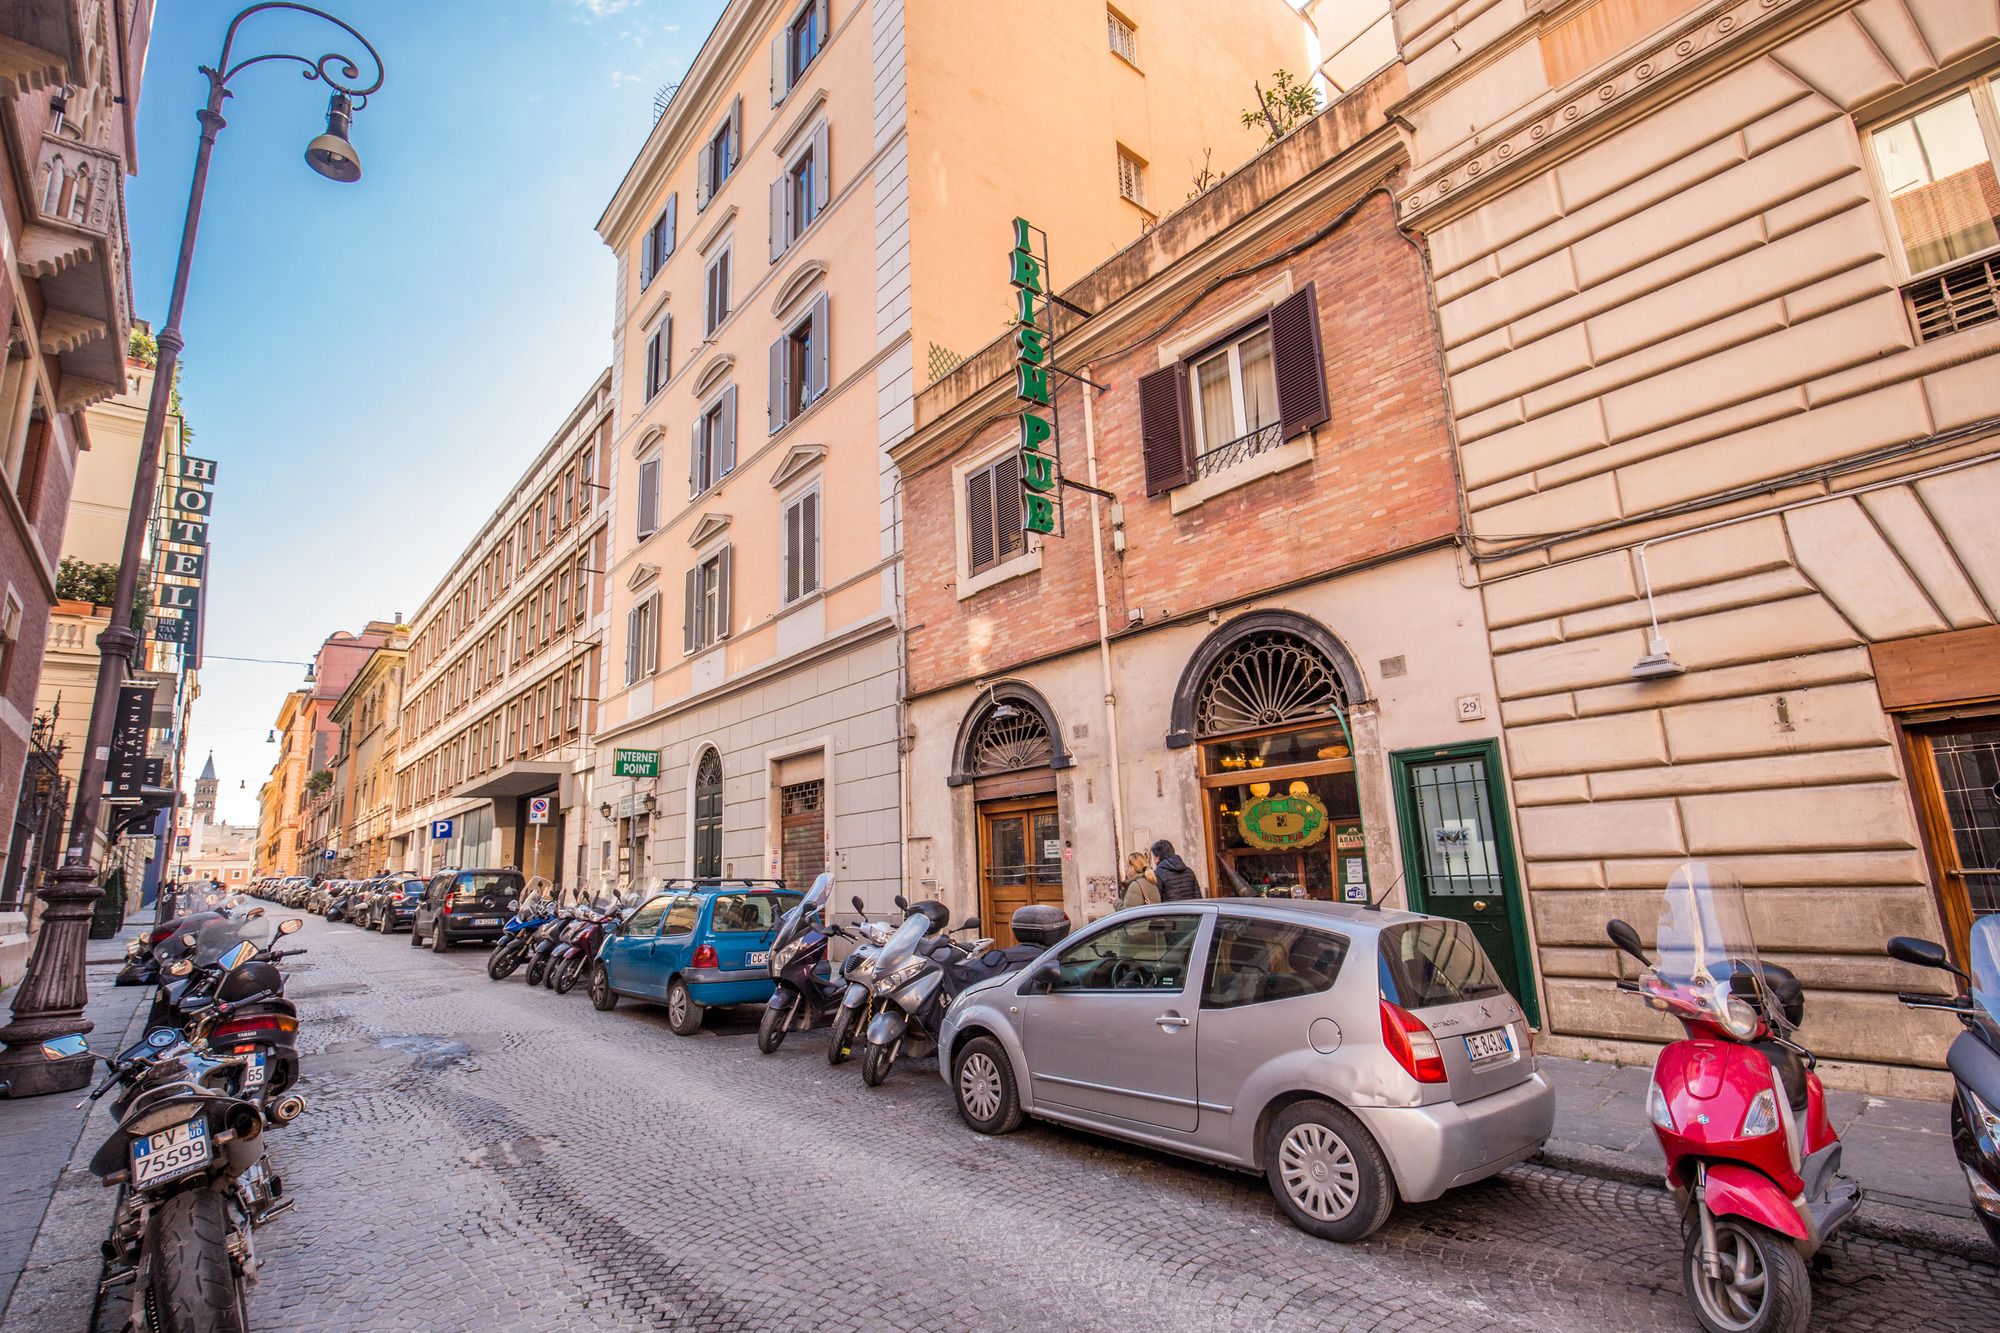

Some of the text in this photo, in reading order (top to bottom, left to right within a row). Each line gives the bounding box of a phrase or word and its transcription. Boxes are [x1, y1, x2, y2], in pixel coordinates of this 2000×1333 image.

[1009, 216, 1055, 534] IRISH PUB
[168, 458, 213, 610] HOTEL
[159, 618, 176, 626] BRI
[158, 625, 177, 633] TAN
[157, 632, 174, 640] NIA
[1462, 702, 1477, 713] 29
[119, 694, 143, 791] BRITANNIA
[617, 751, 658, 763] INTERNET
[623, 763, 651, 775] POINT
[435, 822, 449, 837] P
[179, 837, 188, 845] P
[325, 851, 333, 859] P
[1467, 1037, 1483, 1058] DE
[248, 1068, 263, 1082] 65
[151, 1129, 176, 1151] CV
[190, 1127, 203, 1137] UD
[138, 1141, 205, 1178] 75599
